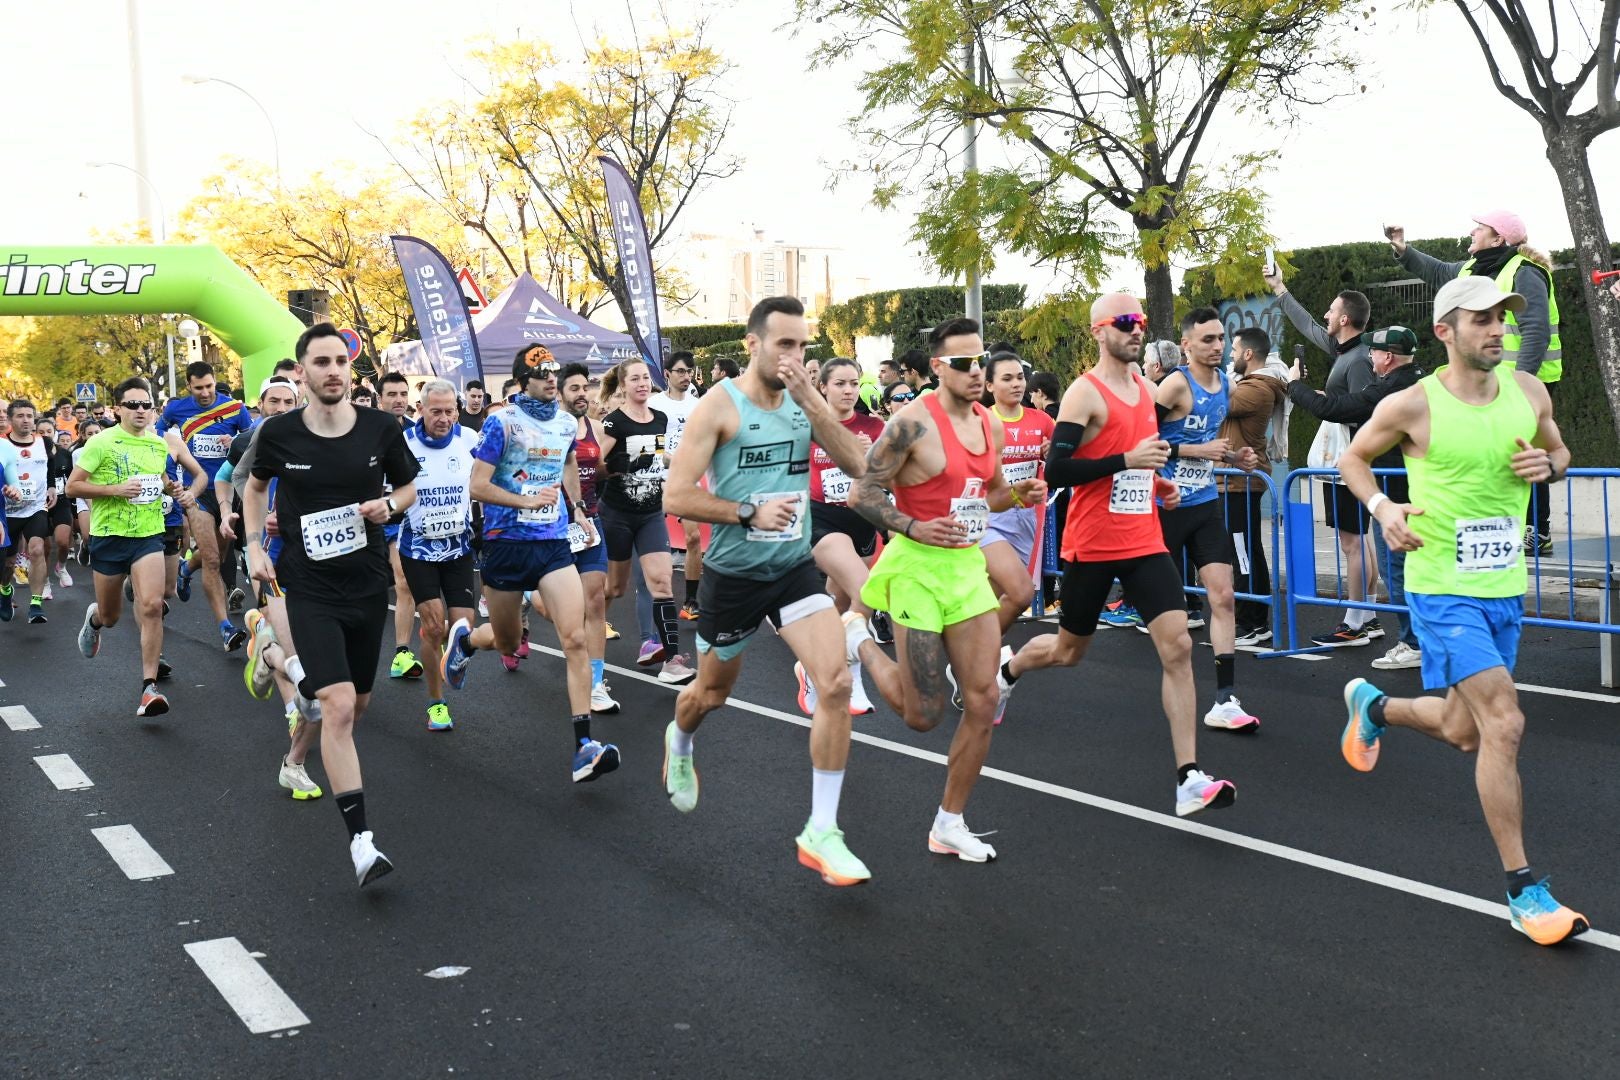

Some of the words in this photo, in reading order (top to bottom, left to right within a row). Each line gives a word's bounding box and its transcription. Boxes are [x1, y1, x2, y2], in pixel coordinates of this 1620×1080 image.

[0, 254, 156, 295] inter
[523, 331, 596, 340] Alicante
[1184, 415, 1207, 429] DM
[1179, 467, 1208, 479] 2097
[141, 487, 159, 497] 952
[417, 486, 463, 496] ATLETISMO
[831, 482, 851, 494] 187
[419, 495, 461, 507] APOLANA
[1120, 489, 1149, 503] 2037
[308, 511, 355, 526] CASTILLOS
[430, 521, 456, 532] 1701
[315, 526, 356, 547] 1965
[1470, 541, 1513, 559] 1739
